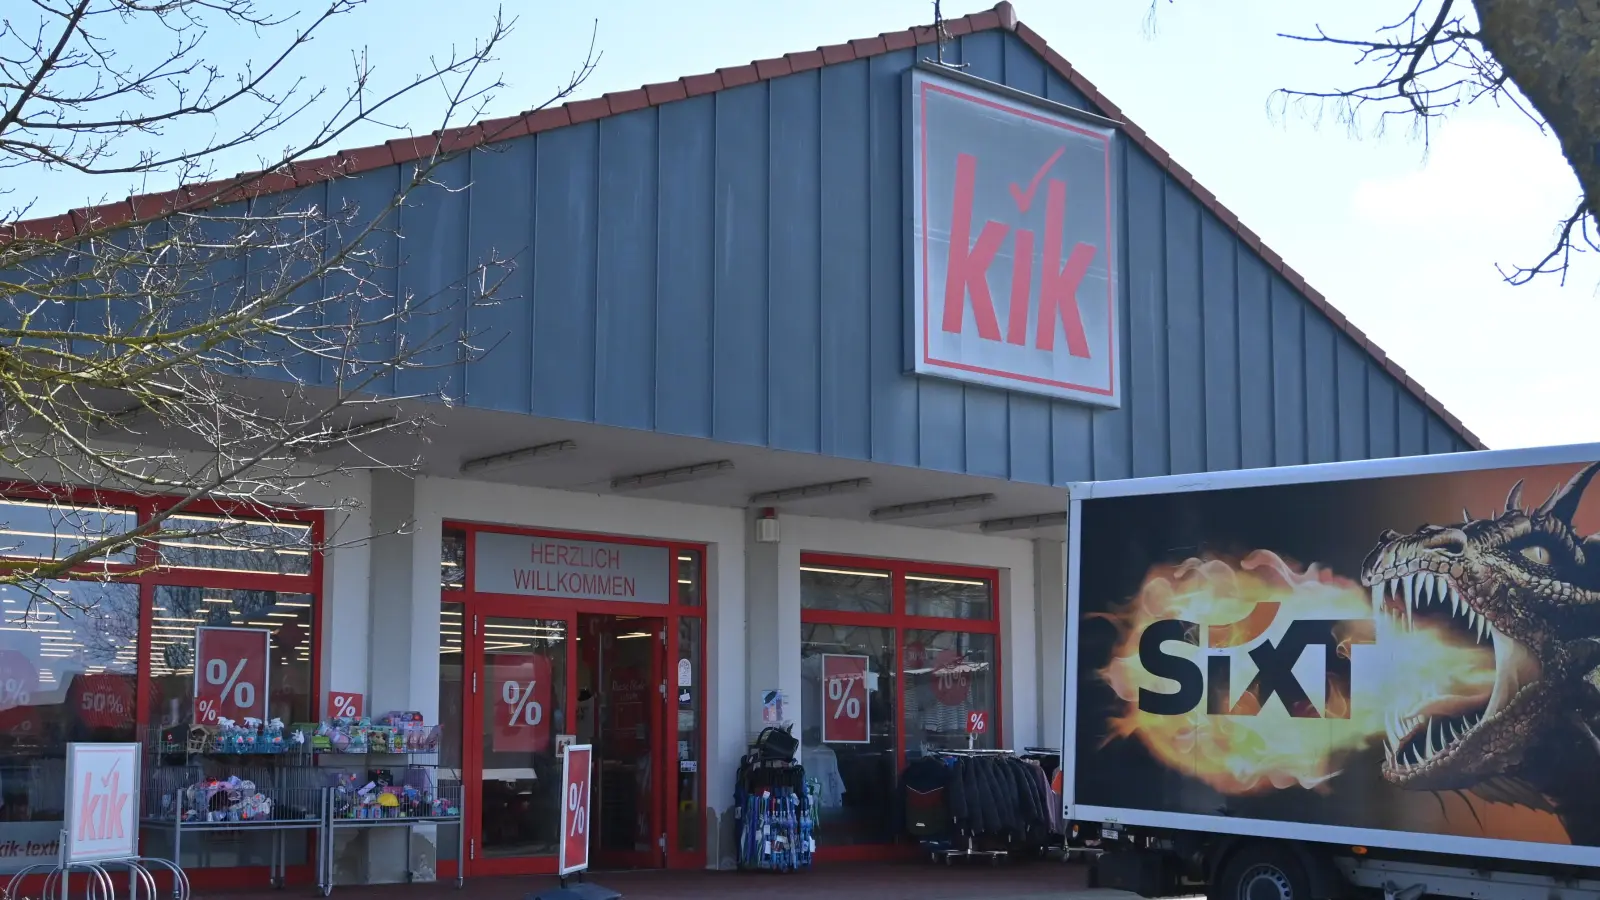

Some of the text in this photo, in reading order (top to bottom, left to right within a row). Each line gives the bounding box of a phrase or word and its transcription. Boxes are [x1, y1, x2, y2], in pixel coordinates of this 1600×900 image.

[531, 542, 620, 570] HERZLICH
[513, 568, 635, 597] WILLKOMMEN
[205, 658, 255, 708] %
[81, 691, 124, 714] 50%
[199, 699, 217, 722] %
[333, 695, 356, 717] %
[502, 680, 542, 726] %
[828, 677, 861, 719] %
[970, 713, 984, 730] %
[569, 780, 585, 837] %
